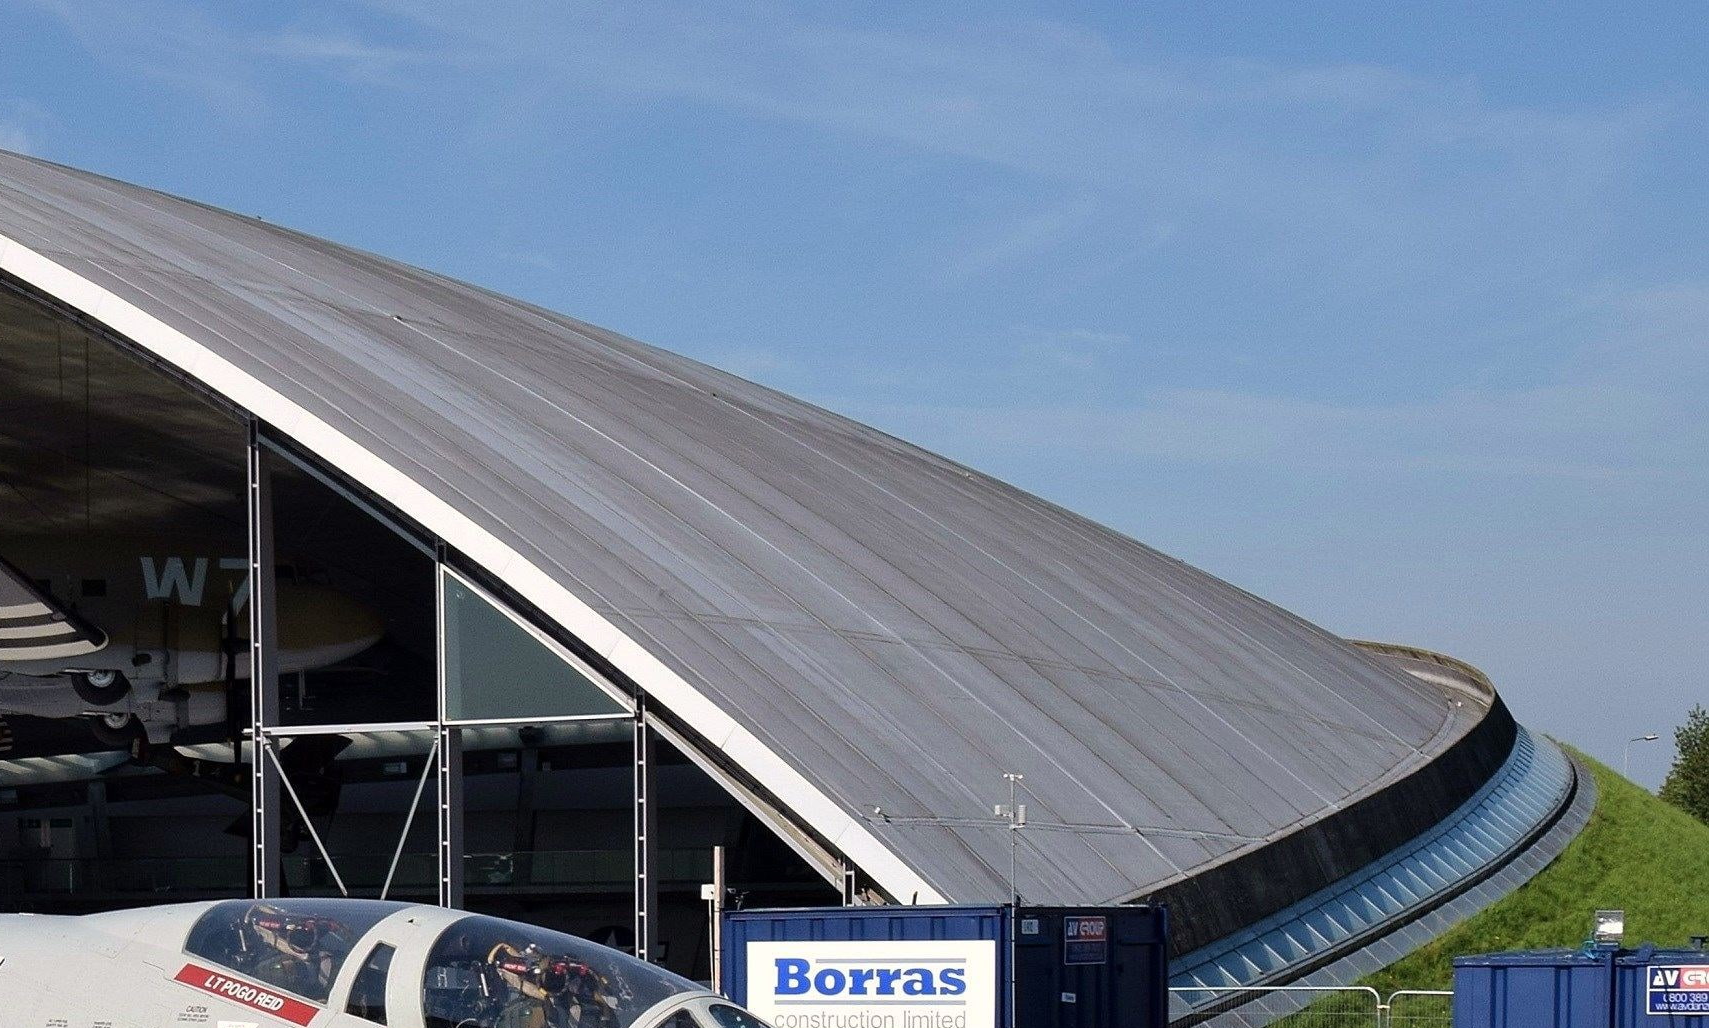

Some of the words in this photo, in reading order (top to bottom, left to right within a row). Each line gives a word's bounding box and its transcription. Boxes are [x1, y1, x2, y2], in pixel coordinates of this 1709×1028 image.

[203, 975, 223, 990] LT
[219, 980, 258, 1001] POGO
[254, 991, 284, 1012] REID
[774, 957, 967, 996] Borras
[1652, 970, 1680, 986] AV
